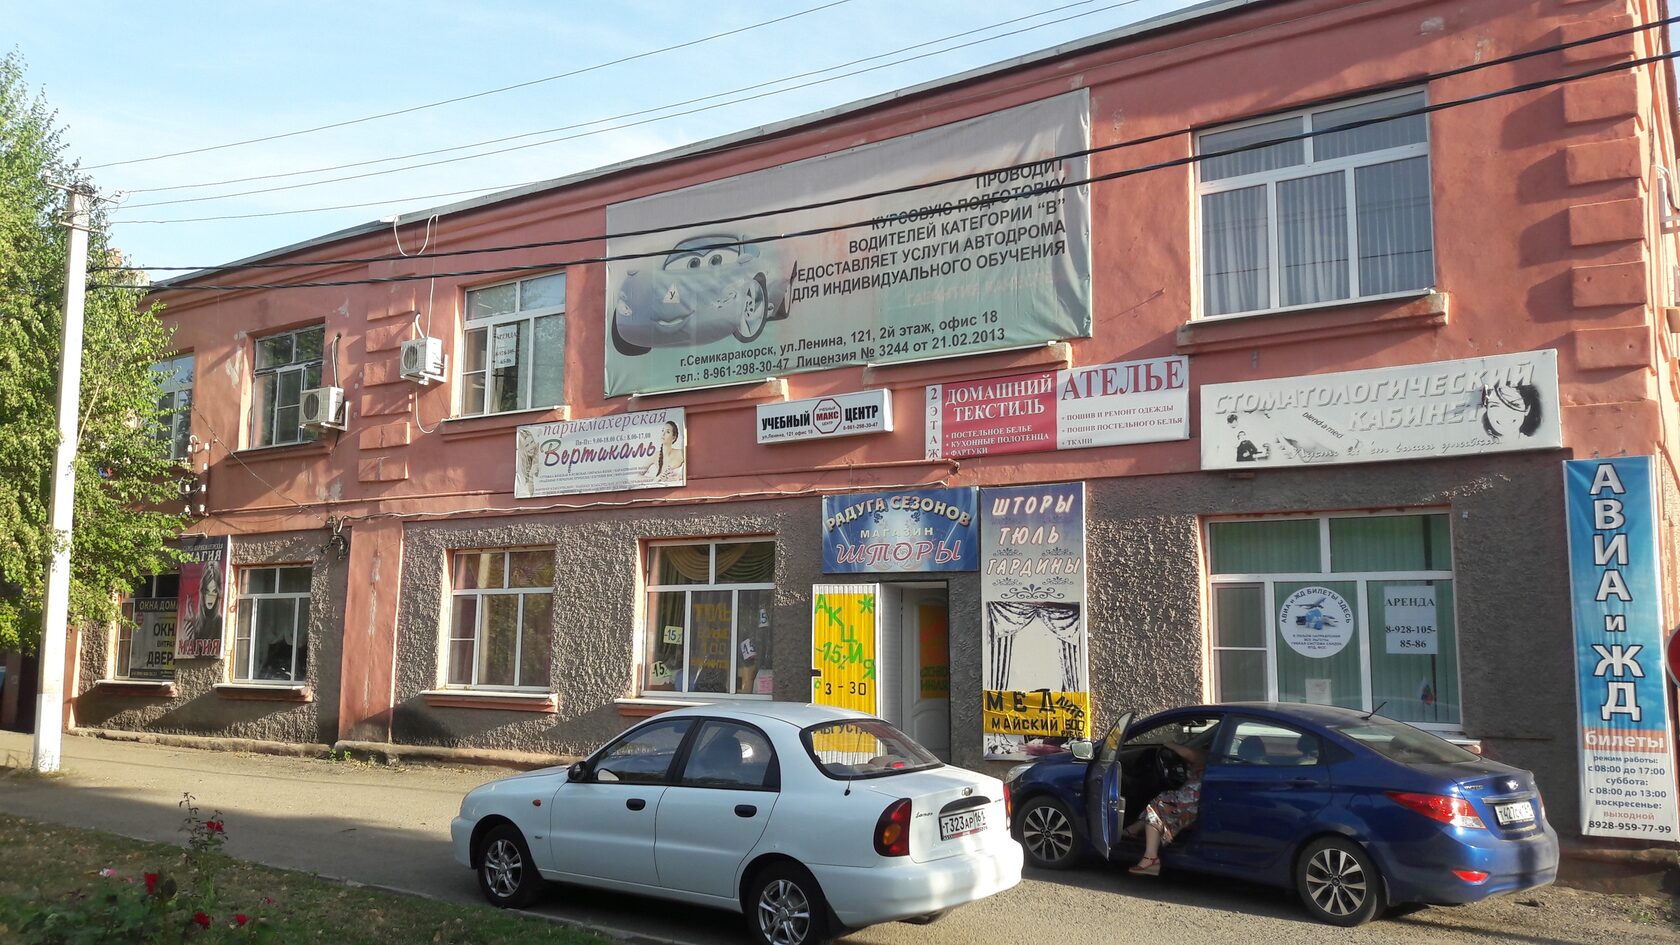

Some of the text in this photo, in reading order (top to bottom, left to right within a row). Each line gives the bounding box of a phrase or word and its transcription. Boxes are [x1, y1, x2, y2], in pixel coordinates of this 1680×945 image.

[849, 222, 936, 254] ВОДИТЕЛЕЙ
[941, 204, 1033, 236] КАТЕГОРИИ
[902, 239, 959, 263] УСЛУГИ
[963, 219, 1066, 252] АВТОДРОМА
[791, 284, 820, 303] ДЛЯ
[823, 257, 972, 295] ИНДИВИДУАЛЬНОГО
[976, 240, 1066, 269] ОБУЧЕНИЯ
[680, 310, 998, 367] г.Семикаракорск, ул.Ленина, 121, 2й этаж, офис 18
[703, 358, 790, 380] 8-961-298-30-47
[796, 350, 857, 368] Лицензия
[861, 347, 875, 359] №
[879, 341, 909, 357] 3244
[913, 342, 928, 352] от
[932, 328, 1005, 350] 21.02.2013
[1061, 359, 1185, 401] АТЕЛЬЕ
[1216, 361, 1536, 415] СТОМАТОЛОГИЧЕСКИЙ
[930, 387, 938, 400] 2
[945, 374, 1053, 406] ДОМАШНИЙ
[761, 404, 879, 431] УЧЕБНЫЙ ЦЕНТР
[816, 411, 839, 421] МАКС
[953, 398, 1045, 422] ТЕКСТИЛЬ
[1066, 413, 1096, 421] ПОШИВ
[1104, 408, 1137, 417] РЕМОНТ
[1138, 405, 1174, 413] ОДЕЖДЫ
[1348, 402, 1484, 432] КАБИНЕТ
[543, 411, 668, 439] парикмахерская
[951, 424, 1032, 439] ПОСТЕЛЬНОЕ БЕЛЬЕ
[1066, 417, 1183, 434] ПОШИВ ПОСТЕЛЬНОГО БЕЛЬЯ
[951, 433, 1049, 448] КУХОННЫЕ ПОЛОТЕНЦА
[1067, 438, 1093, 446] ТКАНИ
[540, 438, 657, 473] Вертикаль
[950, 447, 988, 457] ФАРТУКИ
[825, 495, 971, 531] РАДУГА СЕЗОНОВ
[991, 493, 1075, 516] ШТОРЫ
[860, 527, 934, 538] МАГАЗИН
[999, 525, 1060, 546] ТЮЛЬ
[1589, 462, 1633, 602] АВИА
[836, 539, 962, 566] ШТОРЫ
[986, 558, 1082, 577] ГАРДИНЫ
[139, 600, 159, 610] ОКНА
[1281, 603, 1292, 624] АВИА
[1294, 590, 1306, 601] ЖД
[1307, 588, 1339, 600] БИЛЕТЫ
[1337, 599, 1351, 624] ЗДЕСЬ
[1384, 597, 1435, 607] АРЕНДА
[1385, 625, 1437, 634] 8-928-105-
[177, 638, 221, 657] МАГИЯ
[1399, 639, 1427, 648] 85-86
[825, 682, 832, 696] 3
[849, 681, 867, 696] 30
[1591, 643, 1646, 722] ЖД
[986, 688, 1056, 714] МЕД
[991, 716, 1058, 731] МАЙСКИЙ
[1585, 730, 1664, 748] билеты
[1623, 756, 1658, 764] работы:
[1594, 765, 1621, 773] 08:00
[1638, 767, 1666, 775] 17:00
[1605, 777, 1649, 786] суббота:
[1596, 787, 1623, 796] 08:00
[1640, 790, 1667, 798] 13:00
[1595, 799, 1662, 809] воскресенье:
[1603, 811, 1655, 820] выходной
[1588, 820, 1672, 833] 8928-959-77-99
